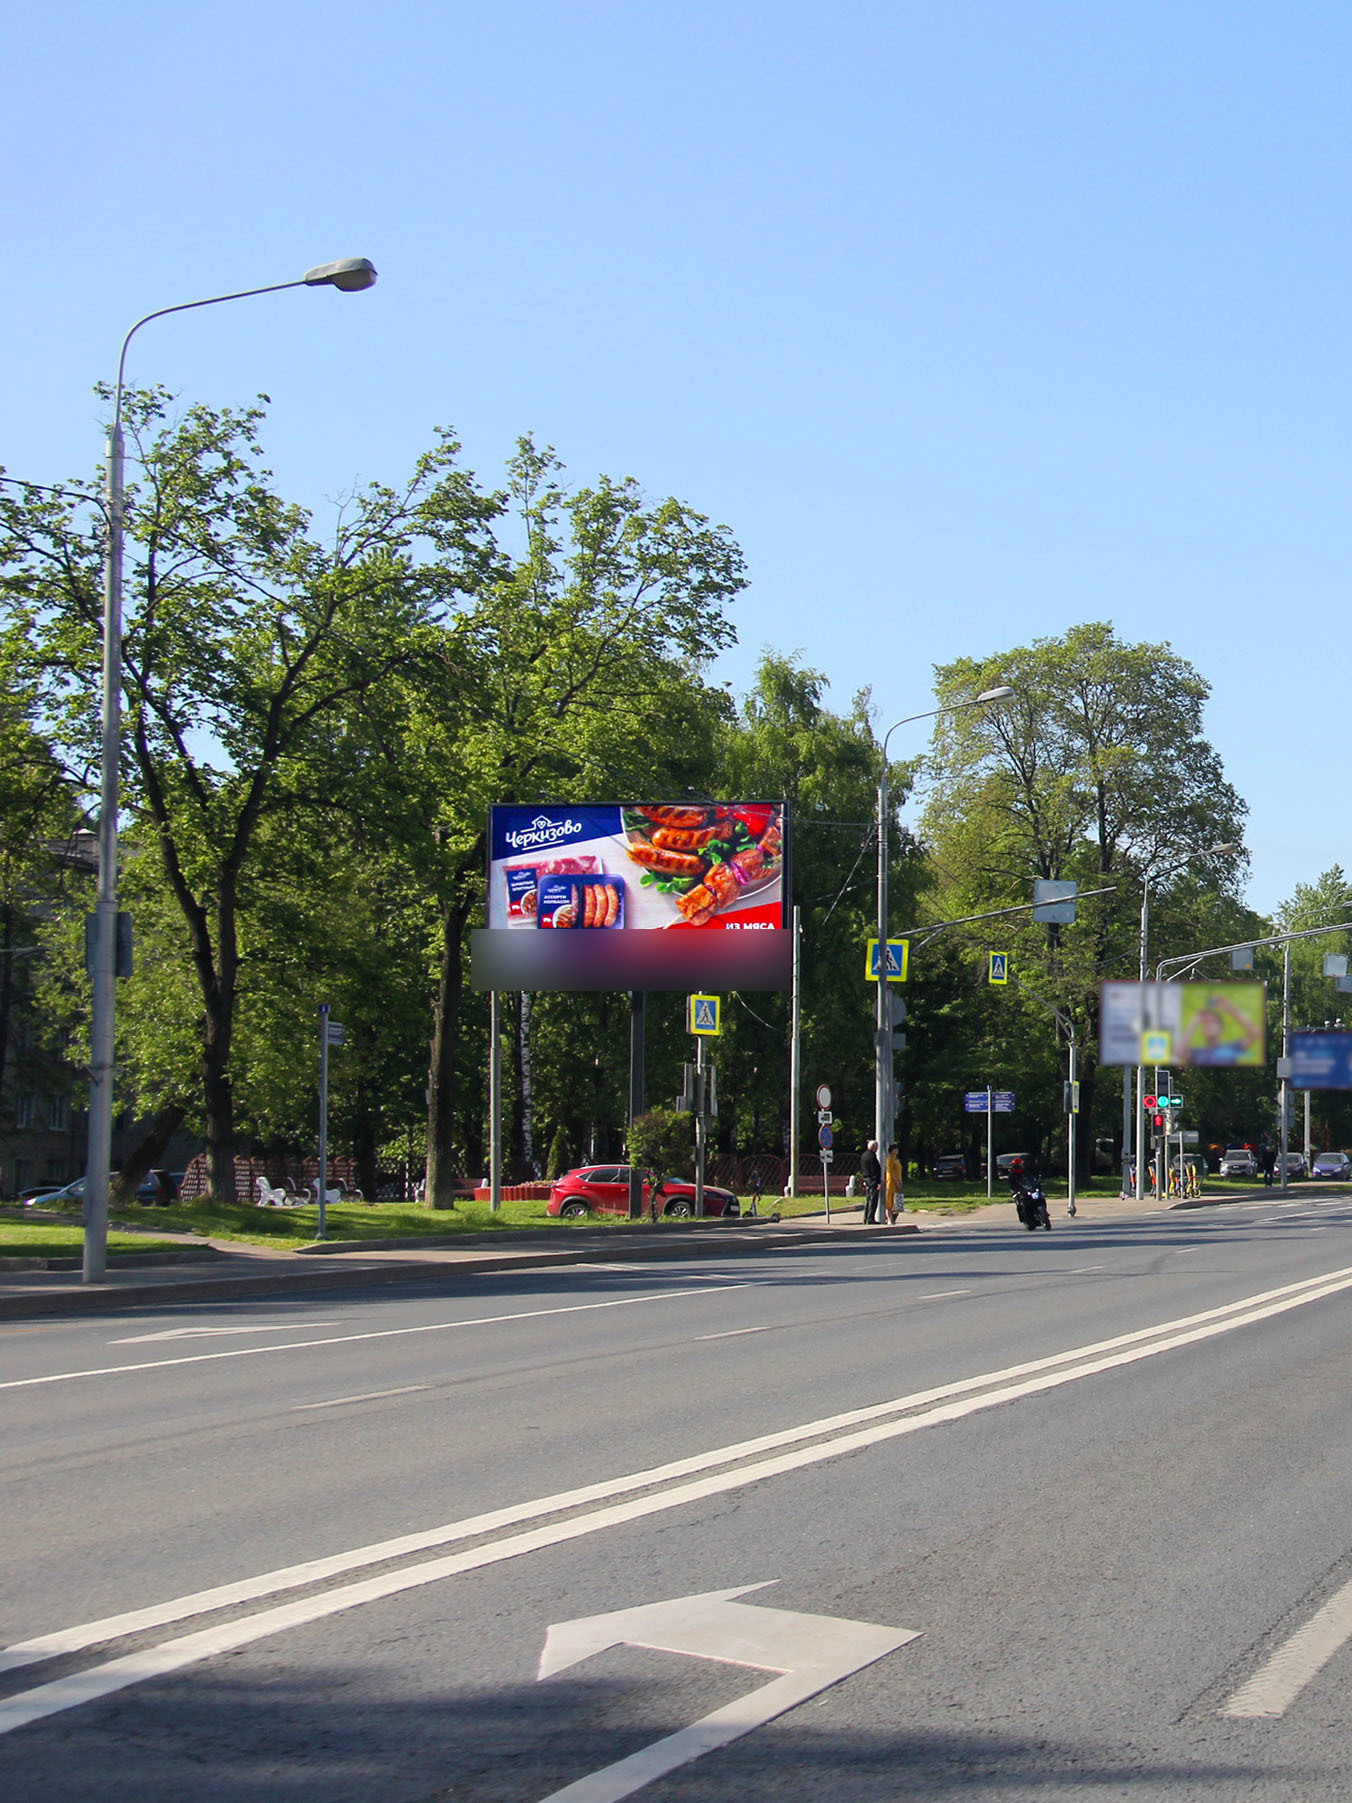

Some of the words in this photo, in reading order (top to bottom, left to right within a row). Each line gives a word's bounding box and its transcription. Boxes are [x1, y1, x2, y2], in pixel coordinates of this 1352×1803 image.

[505, 819, 582, 848] Черкизово
[726, 922, 741, 930] ИЗ
[743, 922, 776, 930] МЯСА
